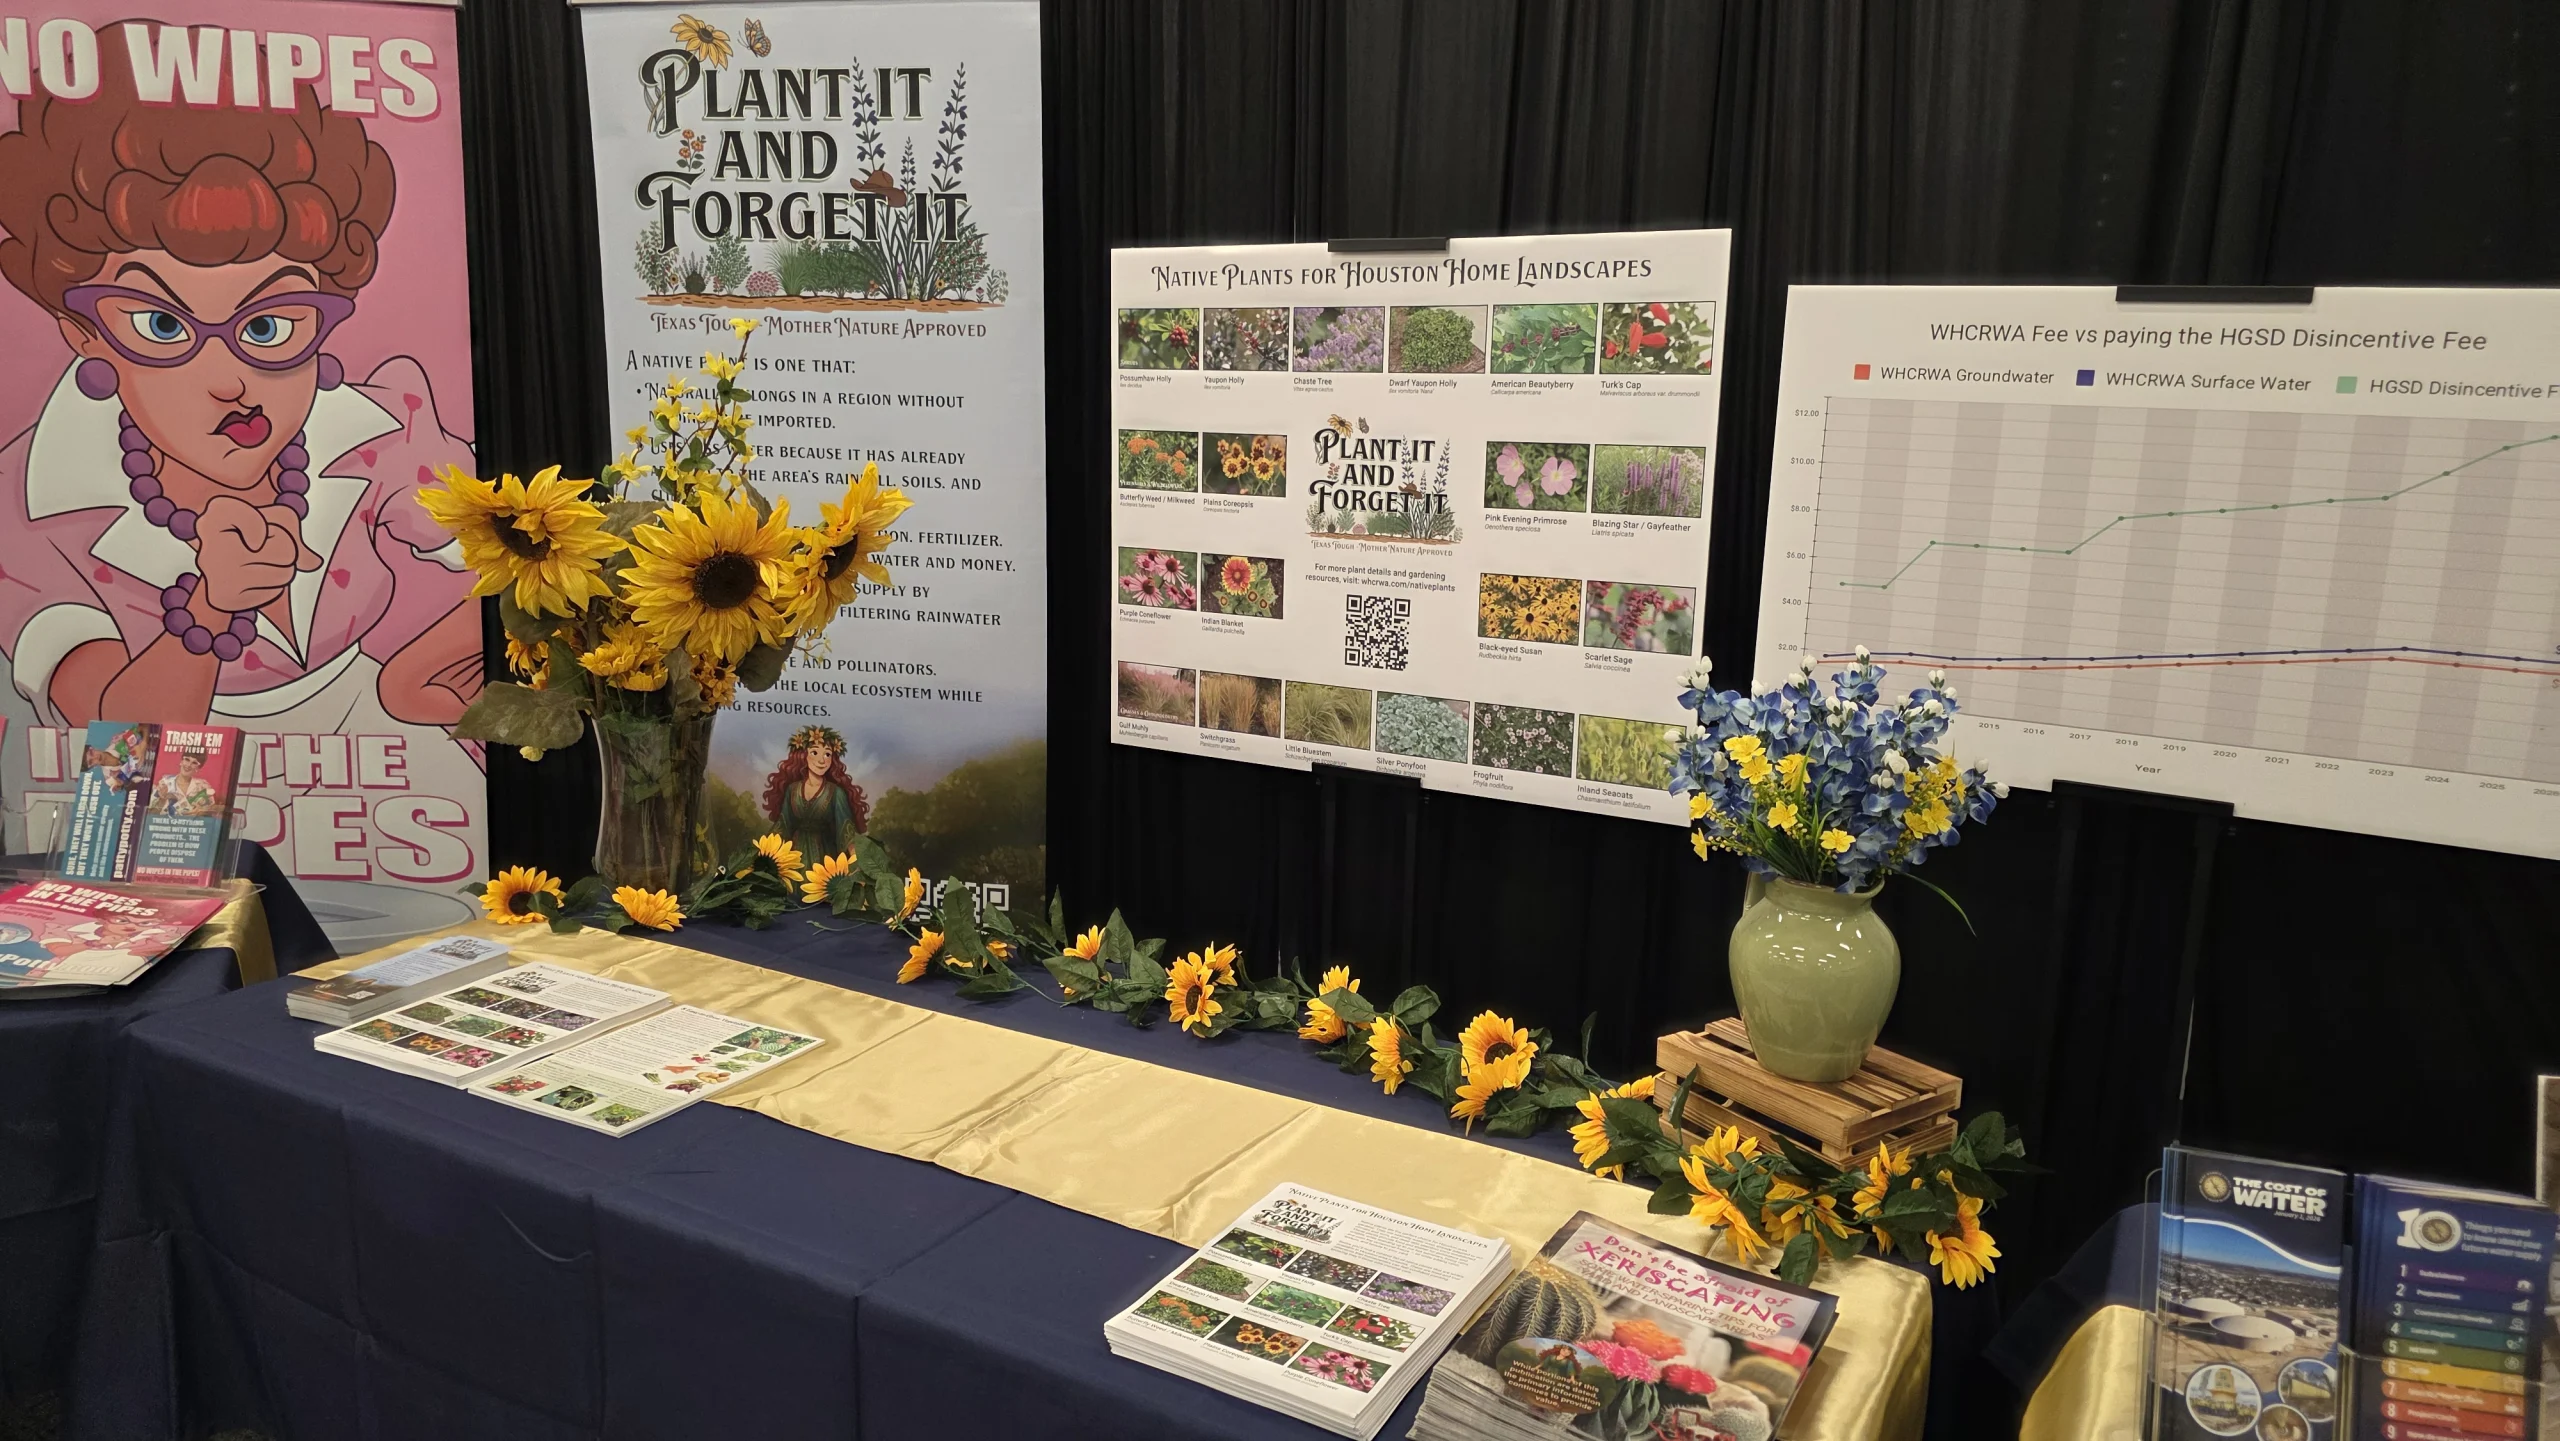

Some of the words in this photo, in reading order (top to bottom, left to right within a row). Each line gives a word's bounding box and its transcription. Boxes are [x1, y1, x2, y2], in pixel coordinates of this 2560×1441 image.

[124, 23, 440, 121] WIPES
[641, 48, 850, 138] PLANT
[872, 67, 931, 120] IT
[714, 130, 838, 182] AND
[635, 169, 889, 254] FORGET
[913, 192, 968, 243] IT
[1151, 265, 1218, 292] NATIVE
[1221, 263, 1293, 291] PLANTS
[1301, 267, 1337, 286] FOR
[1340, 261, 1438, 289] HOUSTON
[1443, 258, 1511, 288] HOME
[1514, 256, 1652, 288] LANDSCAPES
[650, 312, 696, 333] TEXAS
[764, 316, 832, 336] MOTHER
[834, 317, 899, 338] NATURE
[902, 318, 986, 340] APPROVED
[1930, 323, 2026, 343] WHCRWA
[2032, 325, 2068, 343] Fee
[2075, 330, 2098, 343] vs
[2103, 327, 2172, 349] paying
[2178, 327, 2213, 346] the
[2219, 327, 2286, 347] HGSD
[2293, 328, 2435, 350] Disincentive
[2443, 331, 2488, 351] Fee
[626, 349, 639, 371] A
[642, 355, 693, 369] NATIVE
[754, 358, 768, 371] IS
[774, 359, 806, 373] ONE
[812, 360, 855, 374] THAT:
[1119, 374, 1156, 384] Possumhaw
[1204, 376, 1228, 386] Yaupon
[1293, 377, 1316, 386] Chaste
[1880, 366, 1952, 382] WHCRWA
[1956, 367, 2055, 385] Groundwater
[2105, 371, 2186, 388] WHCRWA
[2190, 374, 2256, 390] Surface
[2259, 376, 2312, 392] Water
[1410, 379, 1437, 390] Yaupon
[1438, 379, 1458, 390] Holly
[1491, 379, 1527, 389] American
[1528, 380, 1574, 391] Beautyberry
[1600, 380, 1623, 390] Turk's
[1625, 381, 1642, 392] Cap
[2369, 379, 2423, 395] HGSD
[2429, 380, 2543, 399] Disincentive
[802, 391, 817, 404] IN
[822, 392, 832, 405] A
[838, 393, 892, 406] REGION
[897, 394, 965, 409] WITHOUT
[1794, 408, 1820, 418] $12.00
[758, 415, 836, 430] IMPORTED.
[780, 446, 842, 461] BECAUSE
[848, 449, 861, 461] IT
[866, 449, 895, 462] HAS
[901, 451, 966, 465] ALREADY
[1313, 428, 1401, 466] PLANT
[1411, 439, 1435, 463] IT
[1790, 456, 1815, 466] $10.00
[771, 469, 820, 485] AREA'S
[951, 478, 982, 490] AND
[1341, 463, 1395, 487] AND
[1308, 479, 1413, 514] FORGET
[1424, 493, 1448, 515] IT
[1790, 503, 1811, 514] $8.00
[1485, 514, 1501, 523] Pink
[1502, 515, 1532, 526] Evening
[1533, 516, 1568, 526] Primrose
[1592, 519, 1621, 530] Blazing
[1623, 520, 1639, 530] Star
[1647, 522, 1692, 533] Gayfeather
[918, 531, 1003, 548] FERTILIZER.
[871, 553, 920, 568] WATER
[926, 556, 956, 570] AND
[961, 558, 1016, 573] MONEY.
[1786, 551, 1806, 561] $6.00
[1347, 566, 1366, 578] plant
[1367, 568, 1392, 576] details
[1408, 571, 1446, 582] gardening
[1305, 575, 1342, 584] resources,
[1361, 577, 1456, 592] whcrwa.com/nativeplants
[912, 586, 930, 599] BY
[1781, 597, 1802, 607] $4.00
[839, 605, 911, 622] FILTERING
[917, 611, 1002, 627] RAINWATER
[1201, 617, 1220, 626] Indian
[1221, 619, 1244, 628] Blanket
[1478, 643, 1519, 655] Black-eyed
[1520, 646, 1543, 656] Susan
[1777, 643, 1798, 653] $2.00
[802, 658, 832, 670] AND
[837, 659, 937, 677] POLLINATORS.
[1584, 652, 1612, 663] Scarlet
[1613, 655, 1633, 666] Sage
[804, 681, 847, 696] LOCAL
[852, 684, 932, 701] ECOSYSTEM
[938, 689, 984, 703] WHILE
[747, 700, 832, 717] RESOURCES.
[1978, 721, 2001, 731] 2015
[2022, 727, 2045, 736] 2016
[166, 730, 202, 746] TRASH
[204, 733, 223, 748] 'EM
[2068, 732, 2092, 742] 2017
[2115, 738, 2139, 747] 2018
[2162, 743, 2187, 752] 2019
[2212, 749, 2238, 759] 2020
[1376, 756, 1395, 767] Silver
[1396, 758, 1427, 771] Ponyfoot
[2264, 755, 2290, 765] 2021
[2314, 761, 2341, 771] 2022
[1473, 770, 1504, 782] Frogfruit
[2134, 763, 2163, 775] Year
[2368, 768, 2395, 777] 2023
[2424, 774, 2450, 784] 2024
[2478, 781, 2506, 791] 2025
[1577, 785, 1601, 795] Inland
[1602, 788, 1634, 800] Seaoats
[112, 789, 138, 879] pattypotty.com
[25, 889, 52, 900] IN
[55, 892, 96, 908] THE
[94, 901, 159, 917] PIPES
[38, 883, 71, 895] NO
[73, 887, 143, 907] WIPES
[2233, 1176, 2262, 1189] THE
[2264, 1181, 2303, 1195] COST
[2304, 1187, 2327, 1198] OF
[1274, 1199, 1320, 1220] PLANT
[2232, 1186, 2328, 1218] WATER
[1283, 1211, 1309, 1224] AND
[1288, 1187, 1320, 1201] NATIVE
[1319, 1197, 1350, 1211] PLANTS
[1368, 1210, 1408, 1227] HOUSTON
[1408, 1223, 1438, 1236] HOME
[1436, 1229, 1489, 1249] LANDSCAPES
[1603, 1235, 1660, 1265] Don't
[1663, 1259, 1688, 1277] be
[1693, 1274, 1762, 1299] afraid
[1765, 1296, 1793, 1307] of
[1575, 1241, 1796, 1329] XERISCAPING
[1609, 1281, 1642, 1299] AND
[1642, 1293, 1721, 1328] LANDSCAPE
[1719, 1319, 1767, 1342] AREAS
[1618, 1274, 1717, 1316] WATER-SPARING
[1717, 1311, 1746, 1327] TIPS
[1748, 1321, 1777, 1337] FOR
[1509, 1366, 1555, 1386] publication
[1512, 1360, 1536, 1372] While
[1536, 1368, 1572, 1384] portions
[1508, 1380, 1549, 1397] continues
[1560, 1396, 1593, 1411] provide
[1518, 1376, 1551, 1392] primary
[1552, 1386, 1601, 1407] information
